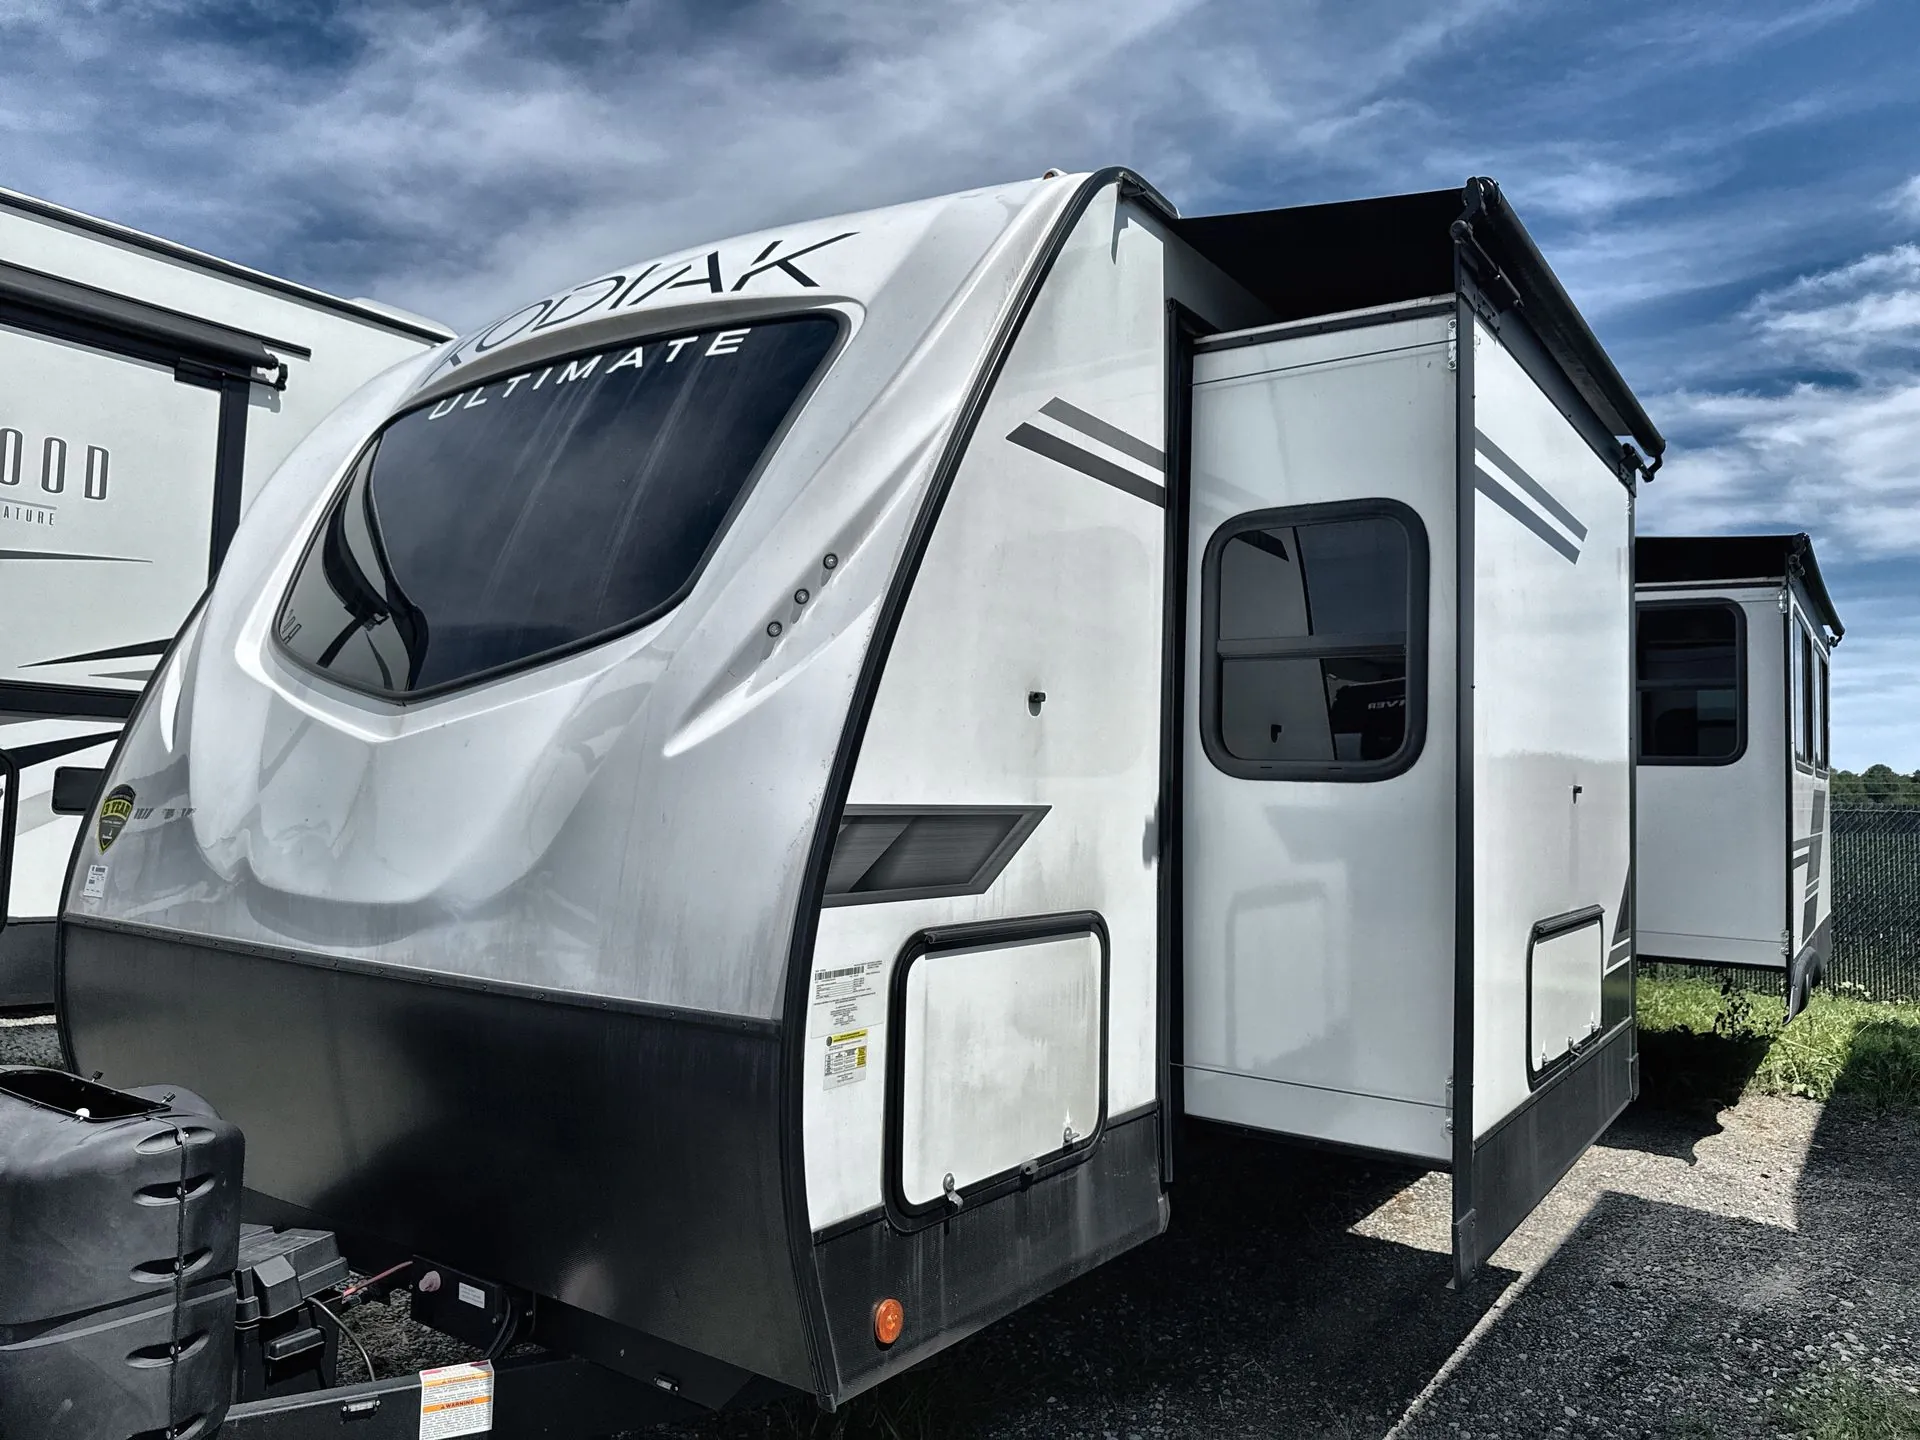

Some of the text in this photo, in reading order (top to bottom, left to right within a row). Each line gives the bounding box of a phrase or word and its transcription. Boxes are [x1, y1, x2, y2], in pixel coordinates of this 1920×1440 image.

[419, 231, 861, 389] KODIAK
[427, 327, 752, 421] ULTIMATE
[446, 1399, 476, 1409] WARNING
